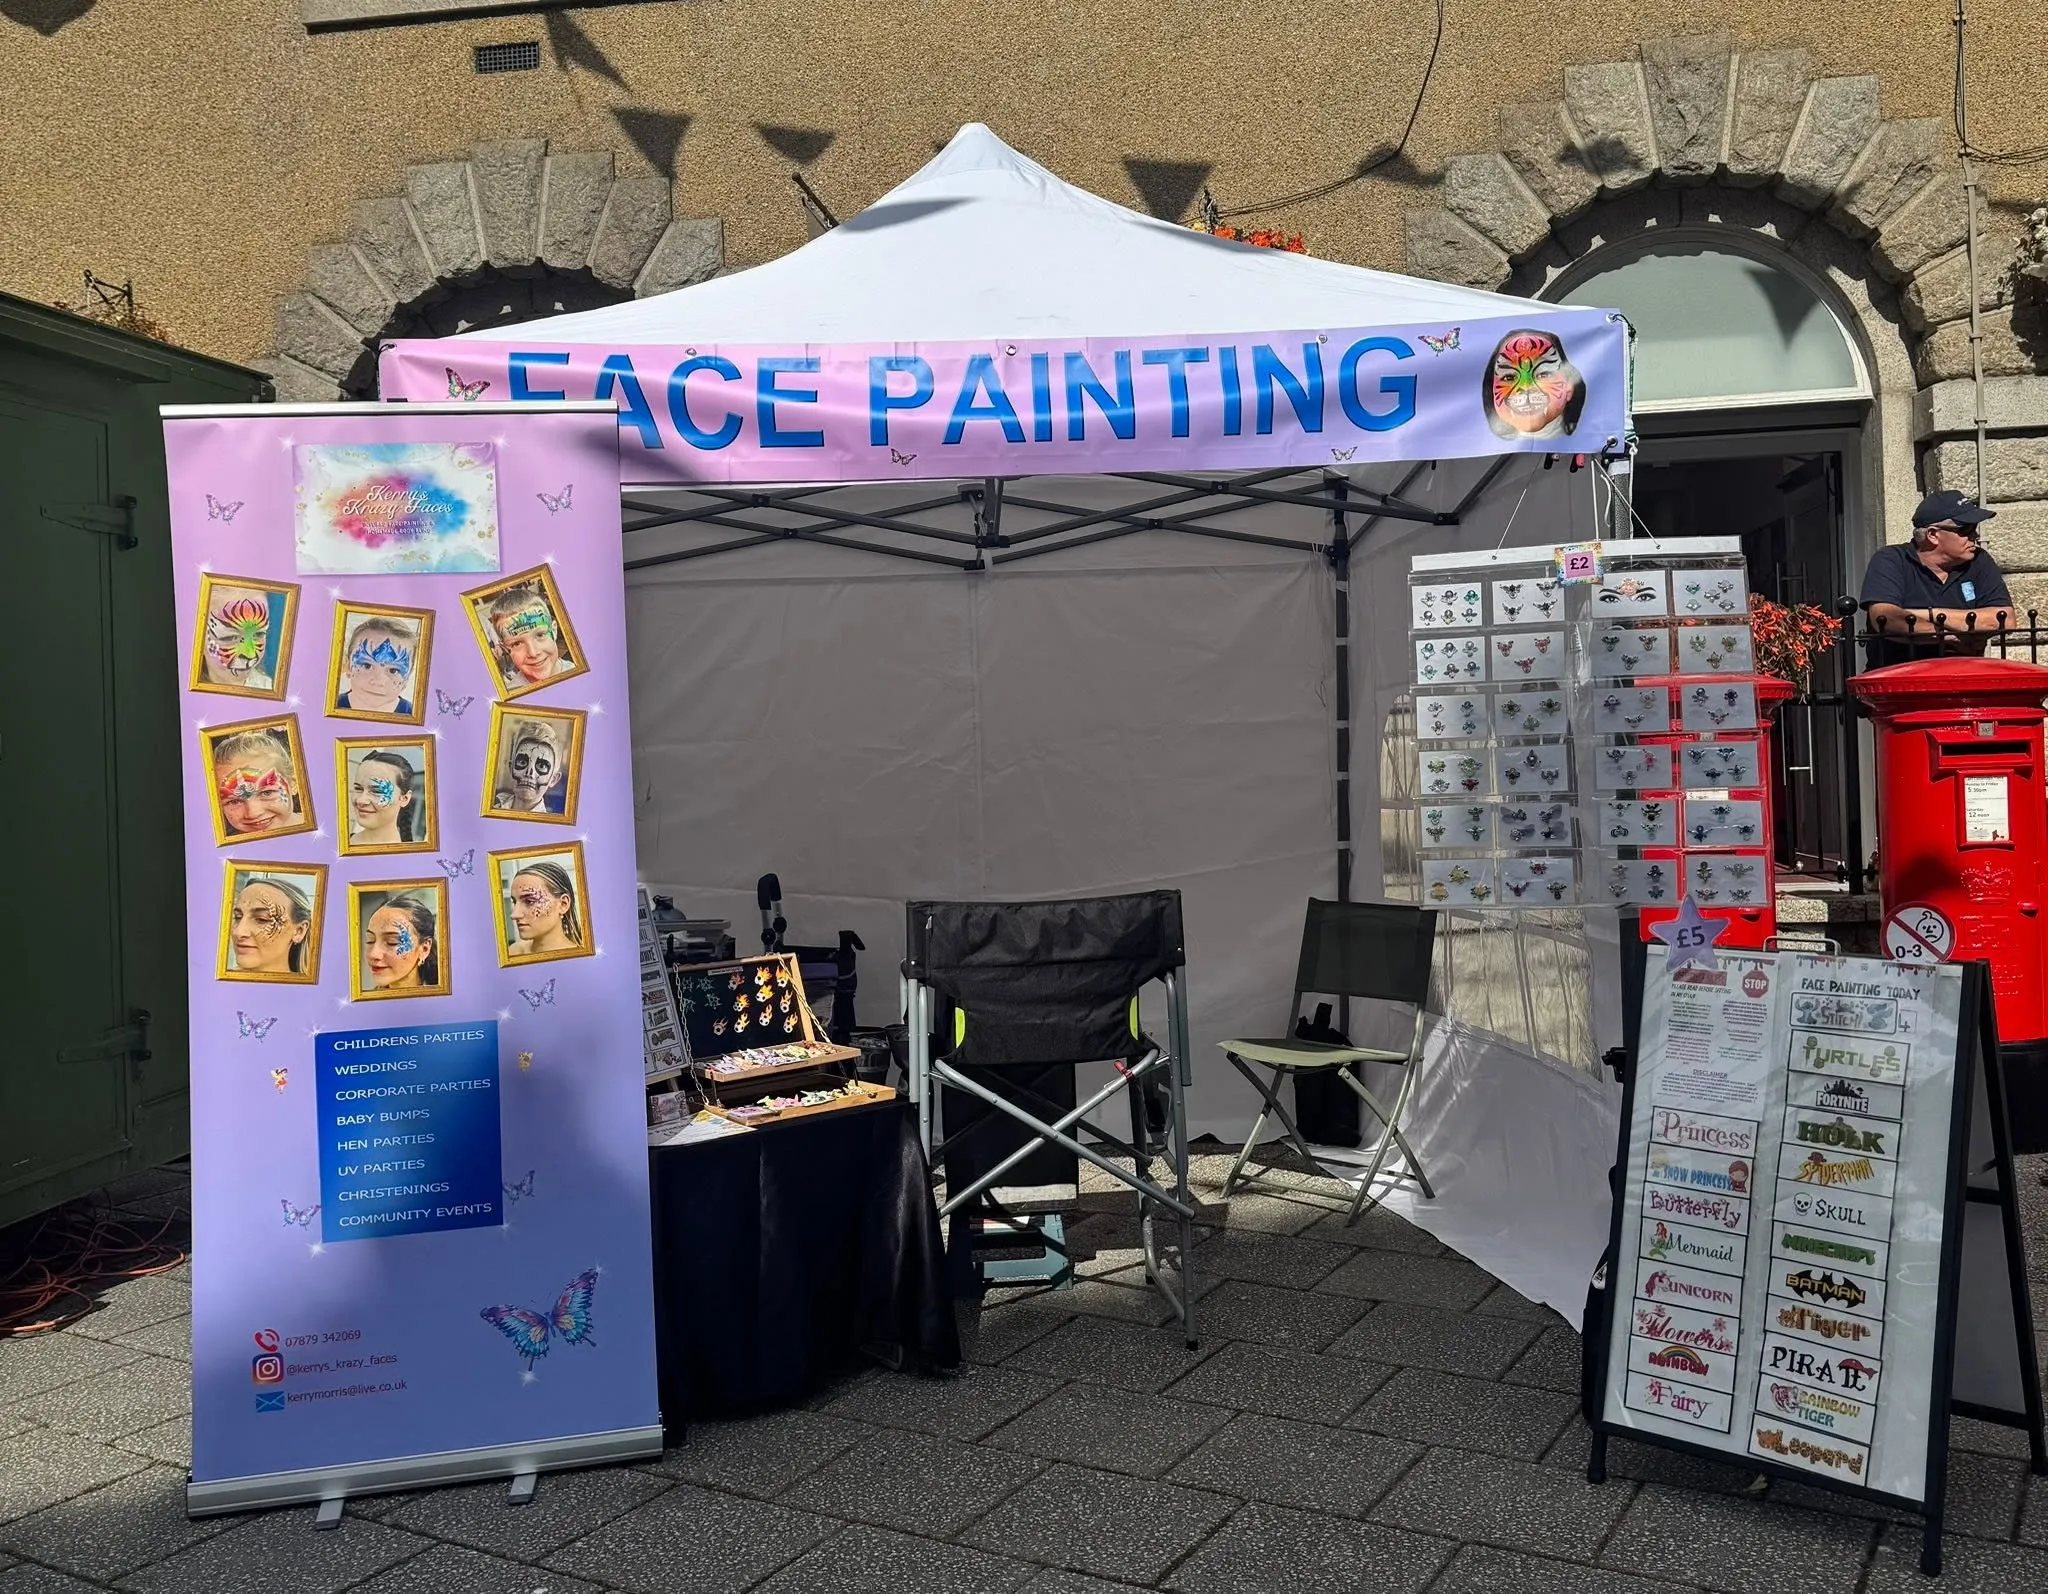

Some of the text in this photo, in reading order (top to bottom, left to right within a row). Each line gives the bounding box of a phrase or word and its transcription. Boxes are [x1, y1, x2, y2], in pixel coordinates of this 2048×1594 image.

[508, 336, 1418, 451] FACE PAINTING
[366, 484, 429, 502] Kerry's
[342, 498, 454, 520] Krazy Faces
[1570, 556, 1589, 570] £2
[1676, 925, 1705, 949] £5
[1895, 943, 1923, 959] 0-3
[1744, 978, 1767, 990] STOP
[1801, 977, 1921, 1001] FACE PAINTING TODAY
[333, 1029, 485, 1052] CHILDRENS PARTIES
[334, 1059, 418, 1077] WEDDINGS
[1802, 1043, 1901, 1073] TURTLES
[1692, 1068, 1728, 1079] DISCLAIMER
[335, 1078, 491, 1102] CORPORATE PARTIES
[1816, 1091, 1869, 1113] FORTNITE
[336, 1108, 430, 1126] BABY BUMPS
[1656, 1110, 1752, 1150] Princess
[1796, 1119, 1886, 1155] HULK
[337, 1133, 435, 1152] HEN PARTIES
[338, 1159, 425, 1177] UV PARTIES
[1663, 1165, 1690, 1183] SNOW
[338, 1181, 450, 1202] CHRISTENINGS
[339, 1202, 493, 1228] COMMUNITY EVENTS
[1650, 1189, 1741, 1228] Butterfly
[1815, 1198, 1866, 1226] SKULL
[1666, 1232, 1734, 1262] Mermaid
[1668, 1283, 1733, 1305] UNICORN
[1787, 1274, 1864, 1302] BATMAN
[285, 1329, 361, 1348] 07879 342069
[1638, 1311, 1725, 1351] Flowers
[286, 1353, 398, 1376] @kerrys_krazy_faces
[1648, 1351, 1710, 1377] RAINBOW
[1769, 1346, 1867, 1392] PIRATE
[287, 1379, 408, 1403] kerrymorris@live.co.uk
[1647, 1385, 1713, 1420] Fairy
[1799, 1389, 1861, 1418] RAINBOW
[1797, 1407, 1835, 1428] TIGER
[1775, 1429, 1864, 1475] Leopard
